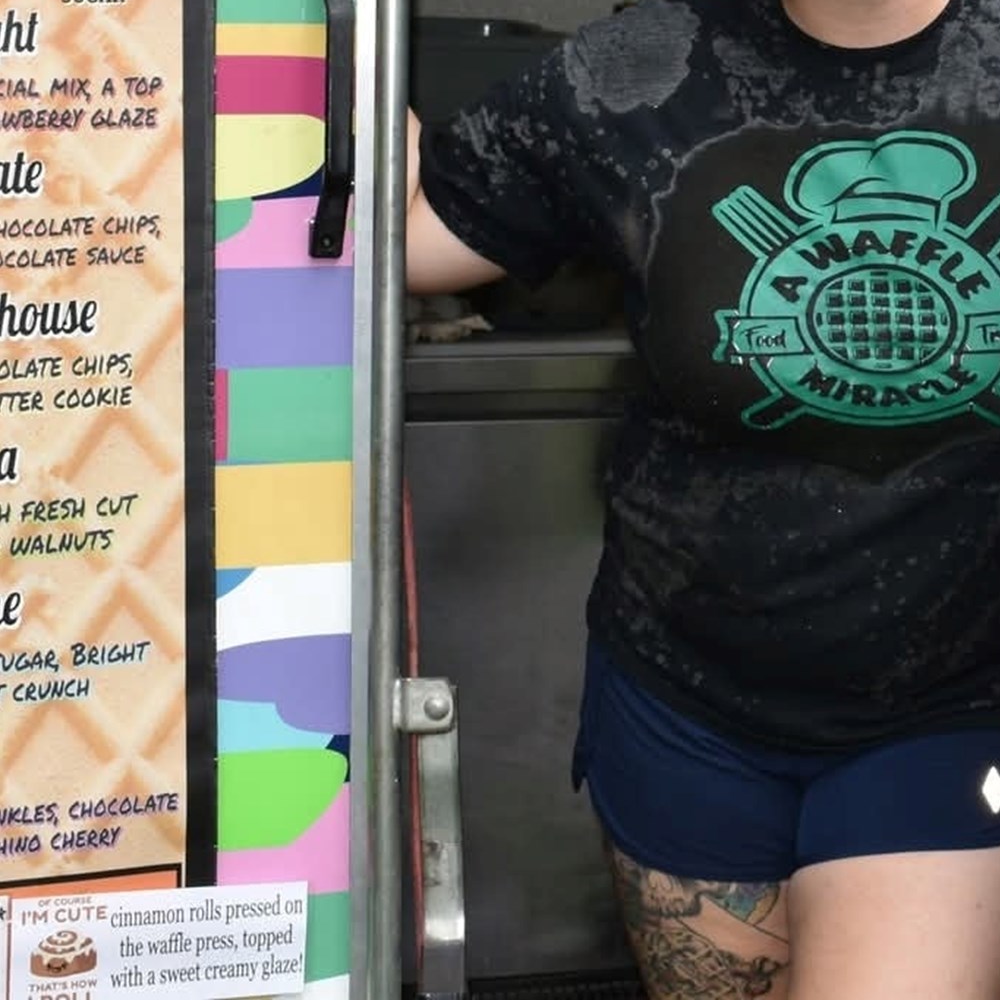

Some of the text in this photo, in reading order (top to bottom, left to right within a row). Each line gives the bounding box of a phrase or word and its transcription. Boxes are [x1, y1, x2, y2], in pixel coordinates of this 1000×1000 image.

[0, 9, 38, 53] ht
[50, 78, 91, 104] MIX,
[101, 78, 115, 96] A
[125, 77, 162, 95] TOP
[91, 108, 157, 128] GLAZE
[103, 214, 160, 239] CHIPS,
[87, 245, 145, 265] SAUCE
[770, 229, 991, 304] A WAFFLE
[0, 293, 97, 336] house
[739, 324, 786, 351] Food
[72, 353, 133, 378] CHIPS,
[53, 386, 133, 409] COOKIE
[797, 365, 978, 406] MIRACLE
[20, 498, 85, 522] FRESH
[96, 494, 138, 516] CUT
[10, 529, 114, 556] WALNUTS
[71, 641, 151, 666] BRIGHT
[13, 678, 90, 701] CRUNCH
[68, 793, 178, 820] CHOCOLATE
[51, 826, 121, 851] CHERRY
[54, 897, 92, 906] COURSE
[110, 894, 303, 928] cinnamon rolls pressed on
[21, 905, 107, 926] I'M CUTE
[120, 923, 293, 958] the waffle press, topped
[110, 952, 304, 988] with a sweet creamy glaze!
[28, 979, 97, 992] THAT'S HOW
